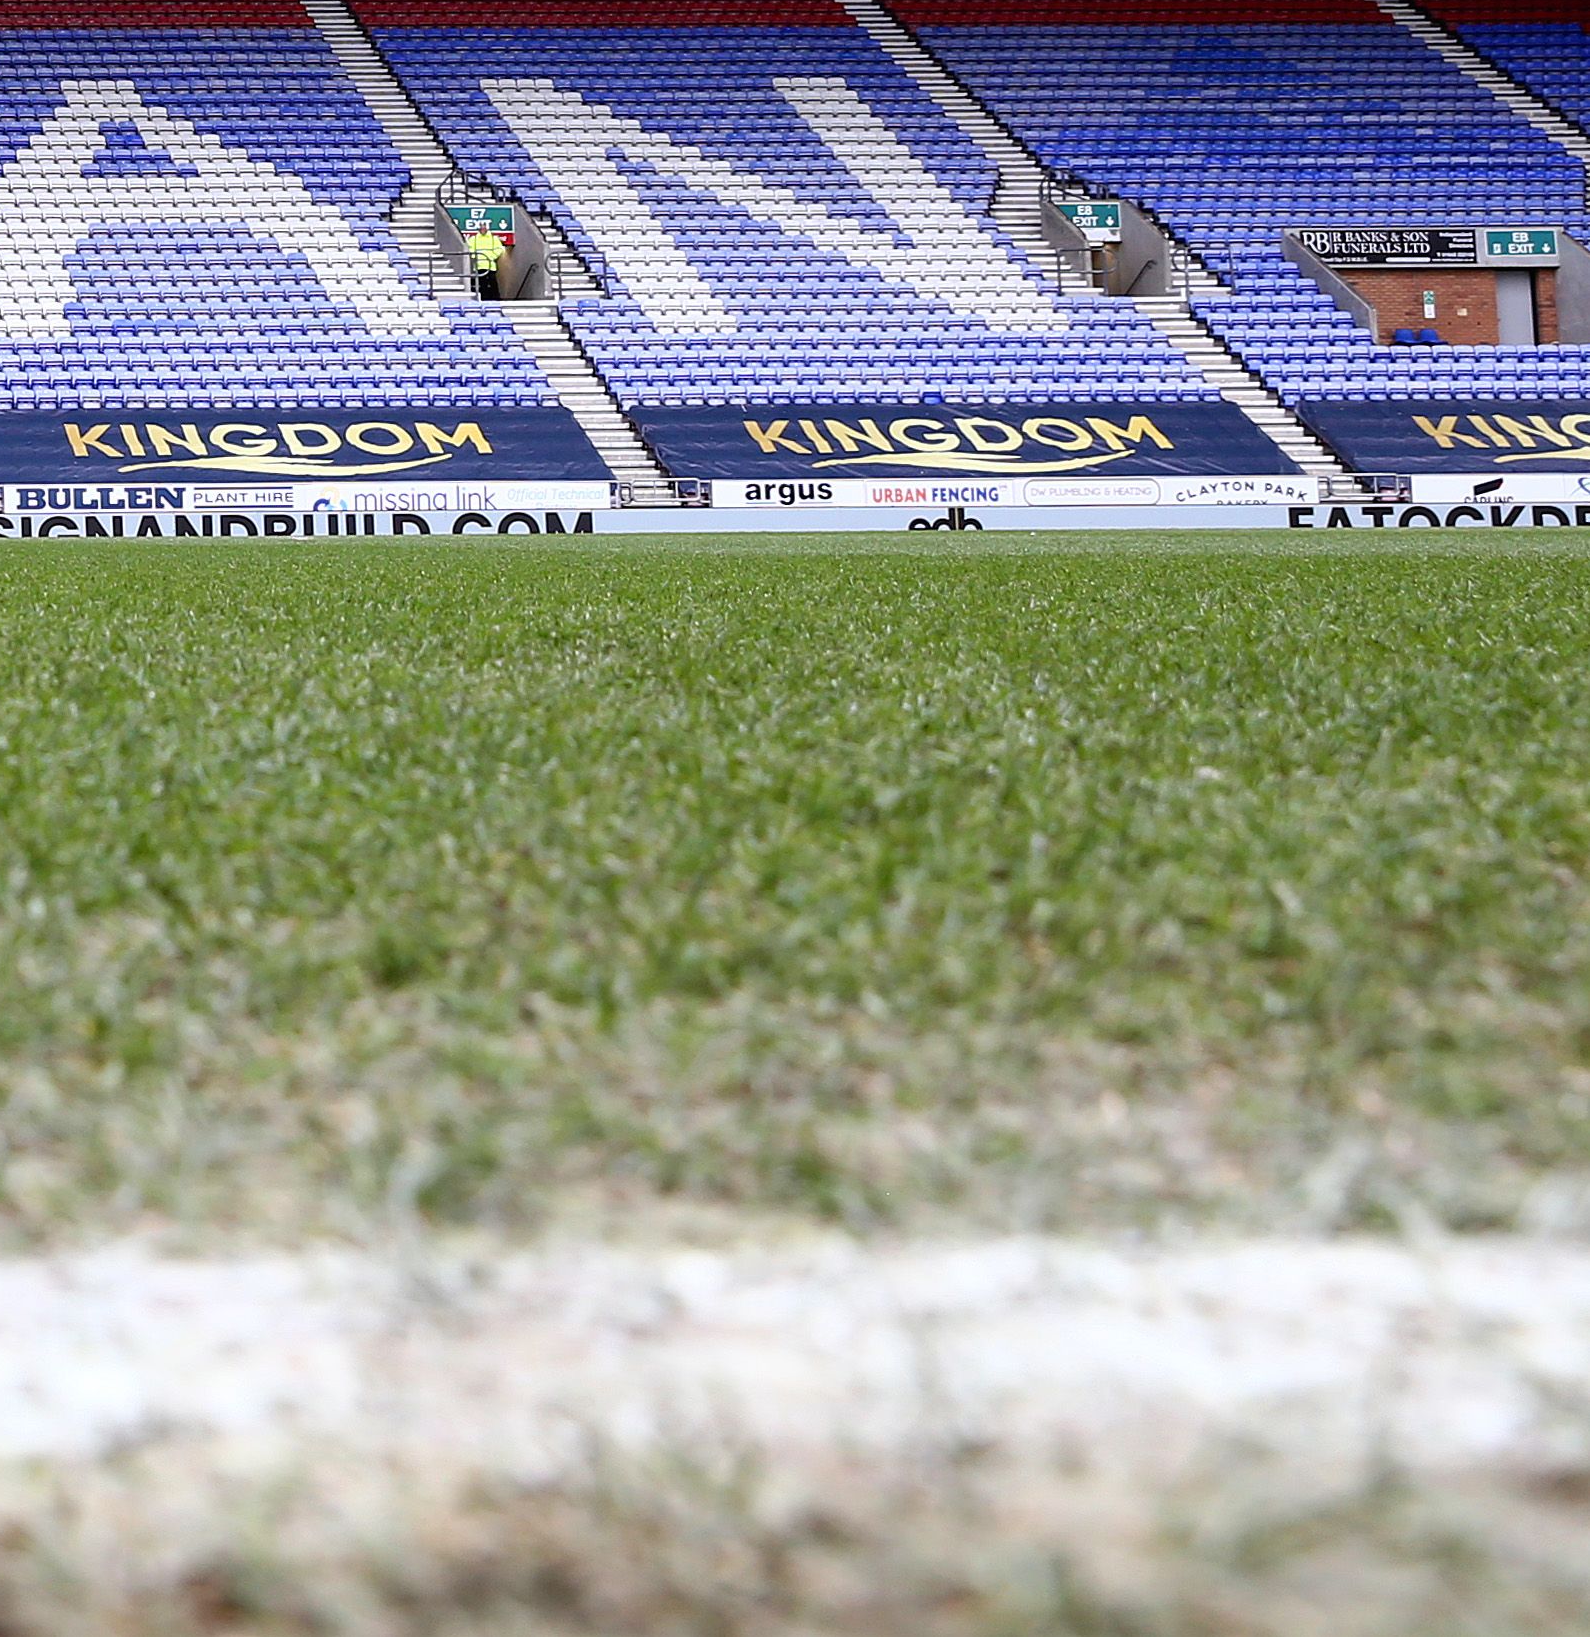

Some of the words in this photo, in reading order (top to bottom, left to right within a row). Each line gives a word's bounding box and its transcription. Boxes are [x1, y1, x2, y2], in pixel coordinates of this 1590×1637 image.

[1072, 216, 1098, 226] EXIT
[1346, 232, 1387, 242] BANKS
[1404, 232, 1429, 242] SON
[1333, 243, 1402, 253] FUNERALS
[1404, 243, 1430, 253] LTD
[1508, 243, 1535, 253] EXIT
[63, 423, 493, 458] KINGDOM
[743, 416, 1174, 454] KINGDOM
[16, 487, 186, 510] BULLEN
[193, 492, 248, 504] PLANT
[255, 491, 294, 503] HIRE
[456, 485, 497, 510] link
[744, 482, 833, 505] argus
[872, 487, 927, 503] URBAN
[932, 487, 999, 503] FENCING
[1175, 481, 1255, 502] CLAYTON
[1264, 482, 1308, 502] PARK
